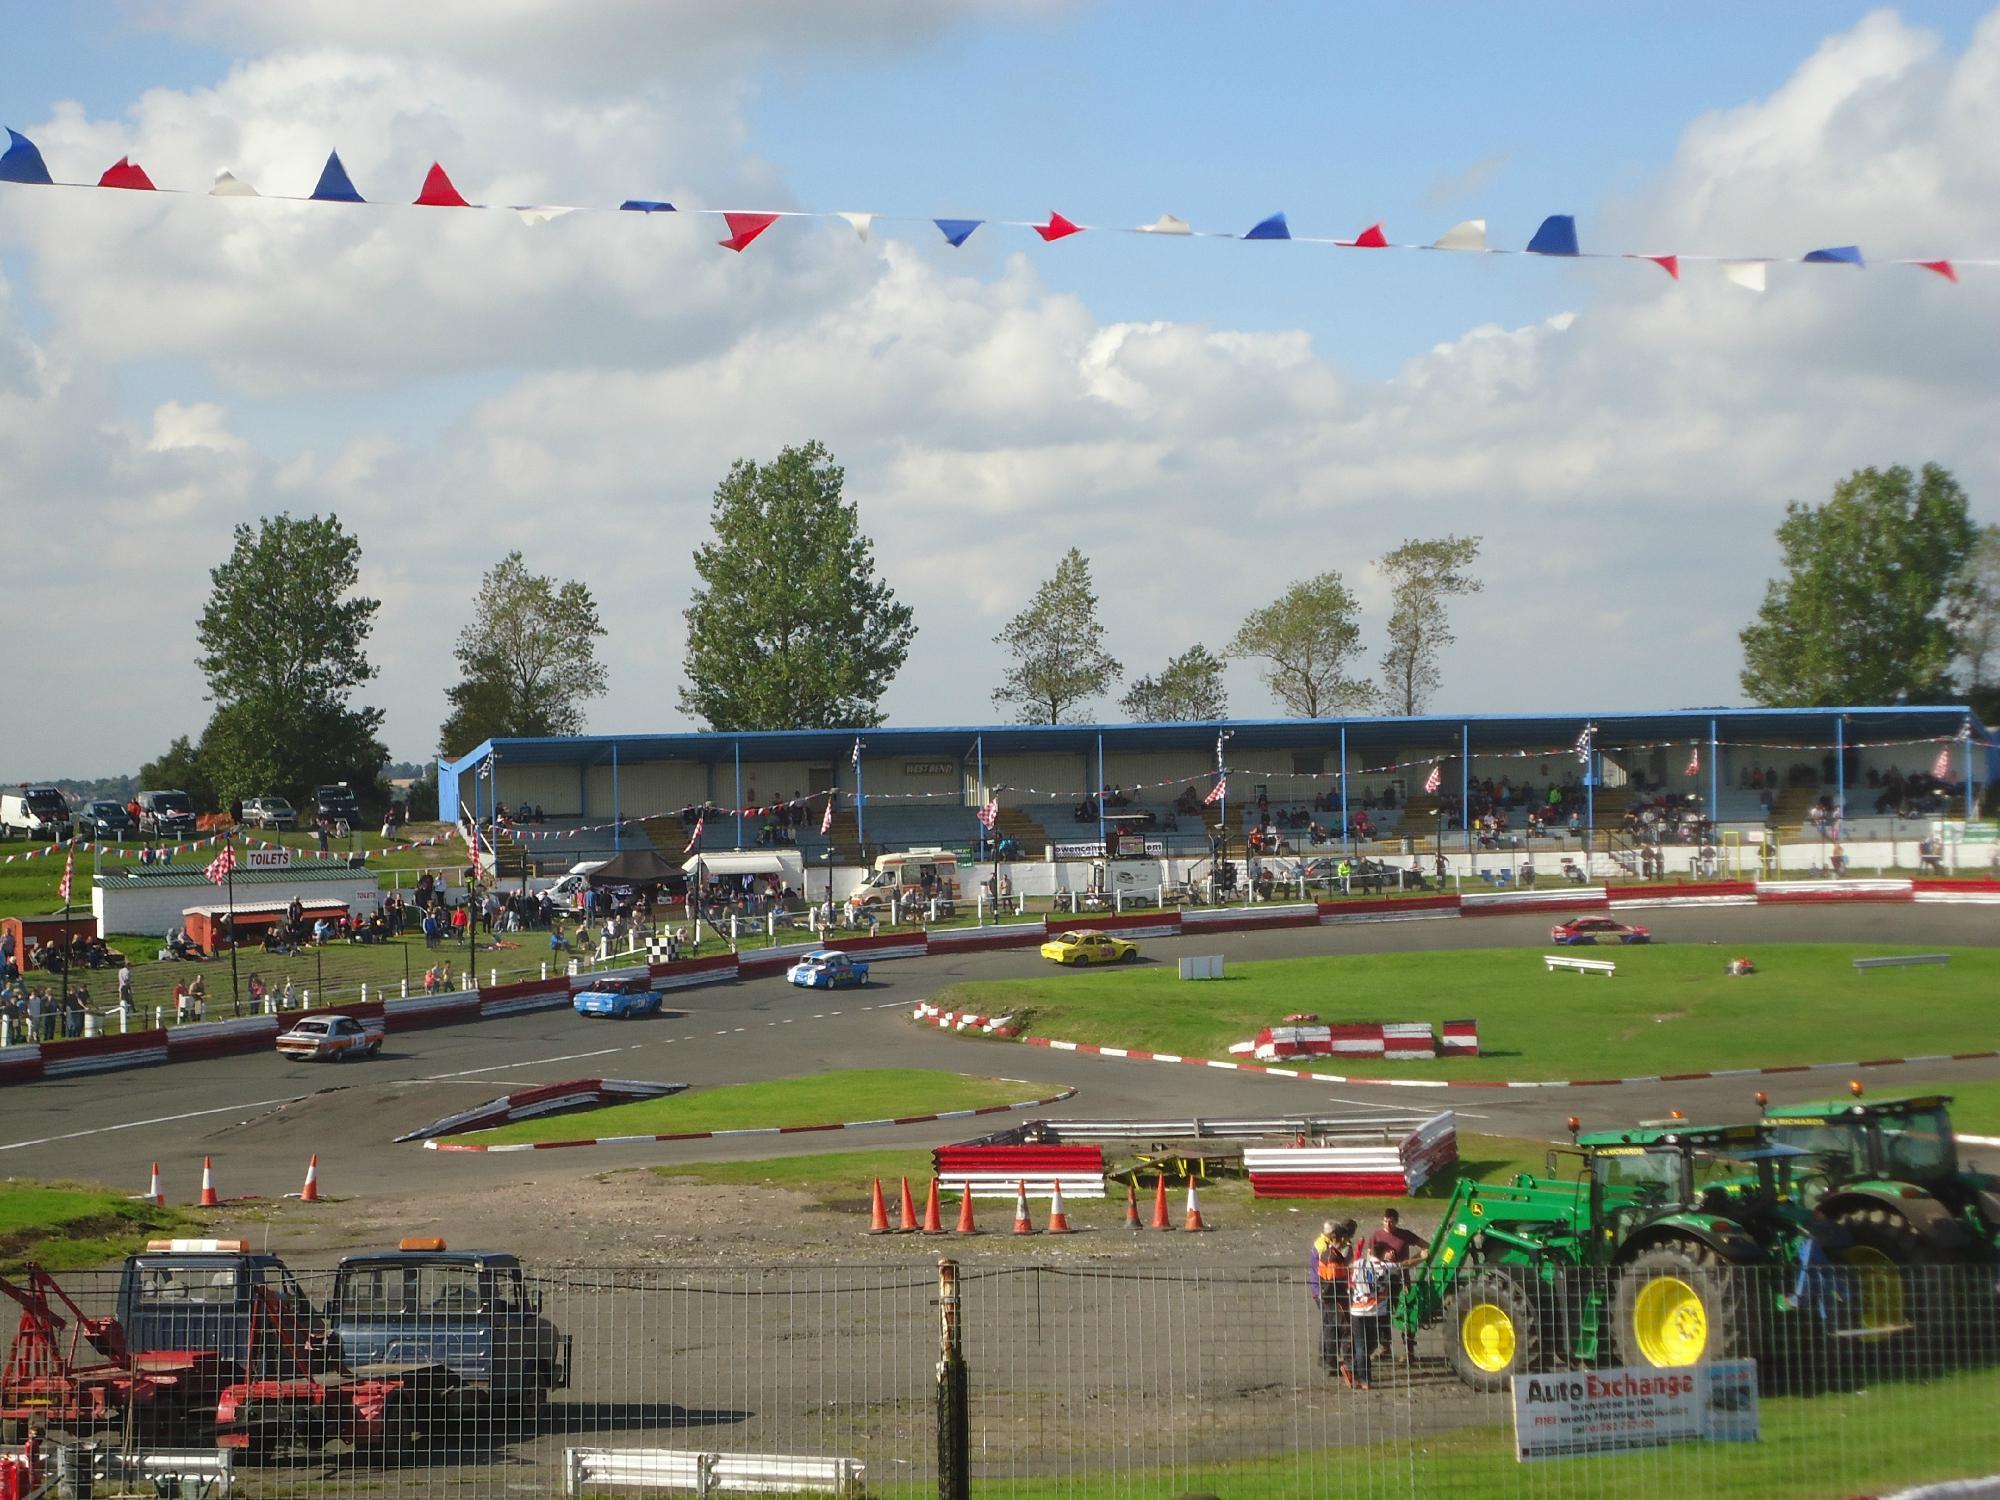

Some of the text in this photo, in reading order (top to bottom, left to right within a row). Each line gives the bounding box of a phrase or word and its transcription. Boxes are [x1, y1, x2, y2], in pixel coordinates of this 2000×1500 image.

[250, 853, 289, 865] TOILETS
[357, 891, 376, 899] TOILETS
[1778, 1117, 1825, 1126] RICHARDS
[1527, 1373, 1694, 1404] Auto Exchange
[1581, 1400, 1623, 1411] advertise
[1535, 1416, 1557, 1426] FREE
[1560, 1413, 1592, 1424] weekly
